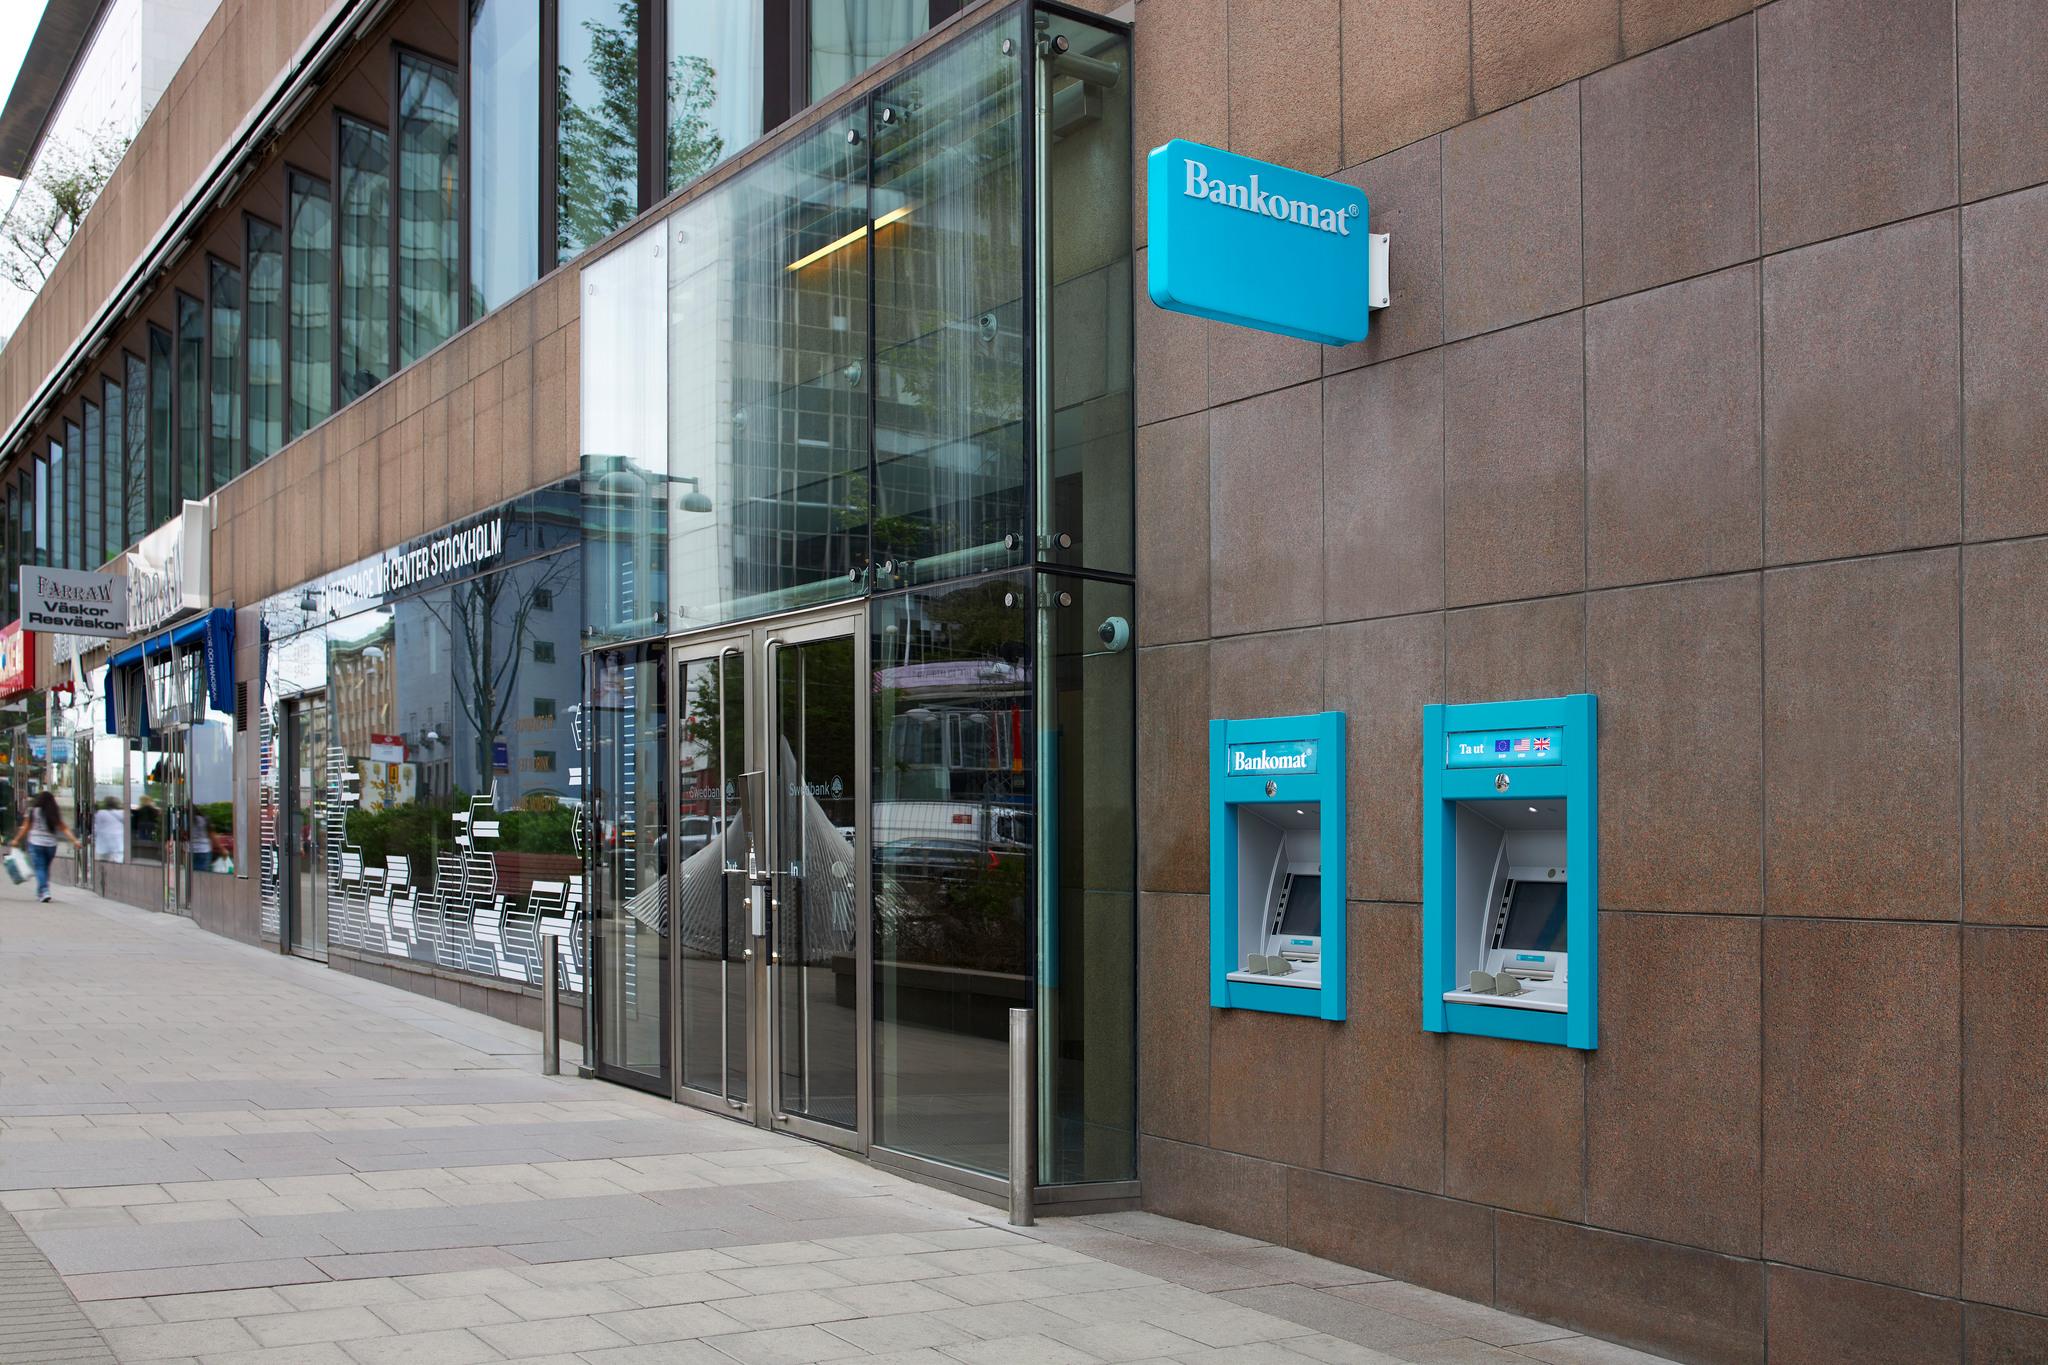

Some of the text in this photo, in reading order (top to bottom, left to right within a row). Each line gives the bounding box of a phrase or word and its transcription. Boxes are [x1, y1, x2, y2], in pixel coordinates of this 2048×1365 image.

[376, 561, 390, 593] VR
[390, 547, 429, 591] CENTER
[431, 518, 502, 577] STOCKHOLM
[37, 575, 114, 603] FARRAW
[44, 601, 109, 617] Väskor
[29, 612, 124, 631] Resväskor
[690, 783, 722, 799] Swedban
